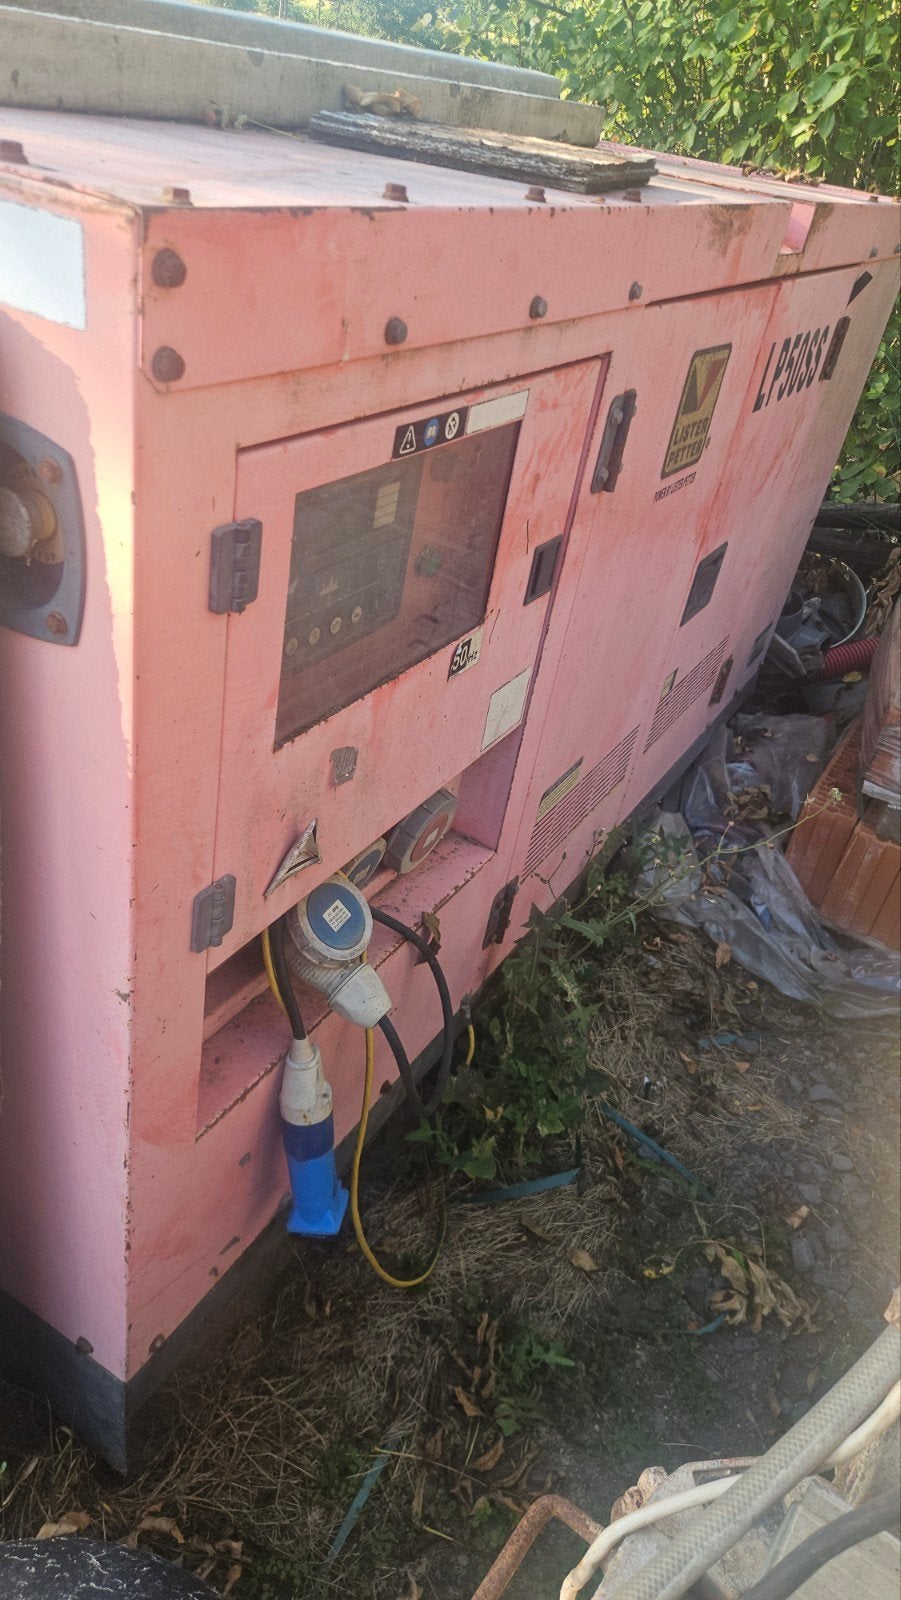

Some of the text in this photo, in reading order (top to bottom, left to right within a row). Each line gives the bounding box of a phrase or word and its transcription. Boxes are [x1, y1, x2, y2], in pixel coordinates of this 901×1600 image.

[752, 325, 829, 413] LP50SS
[673, 417, 709, 447] LISTER
[667, 438, 703, 468] PETTER
